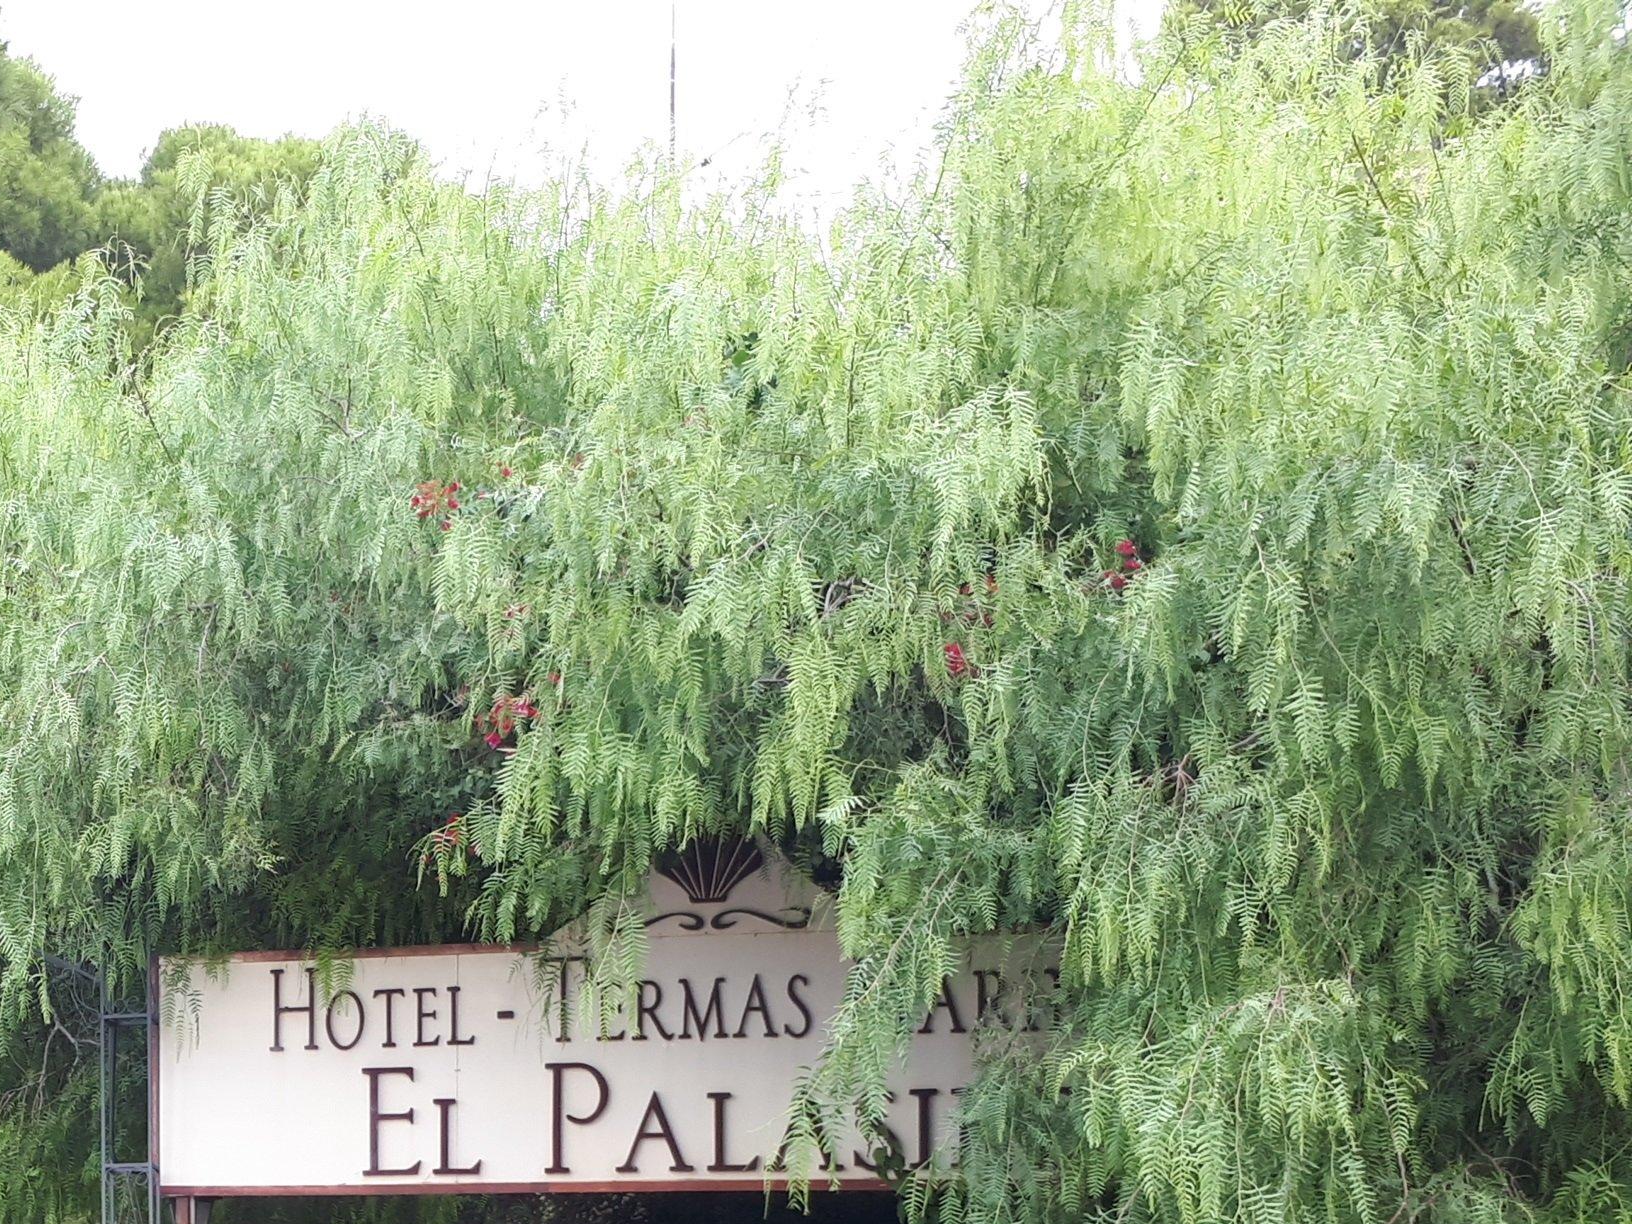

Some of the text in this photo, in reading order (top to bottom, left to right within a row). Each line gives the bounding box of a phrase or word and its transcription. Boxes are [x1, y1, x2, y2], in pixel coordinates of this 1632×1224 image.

[268, 966, 476, 1054] HOTEL
[543, 955, 814, 1044] TERMAS
[362, 1062, 1072, 1177] EL PALASI
